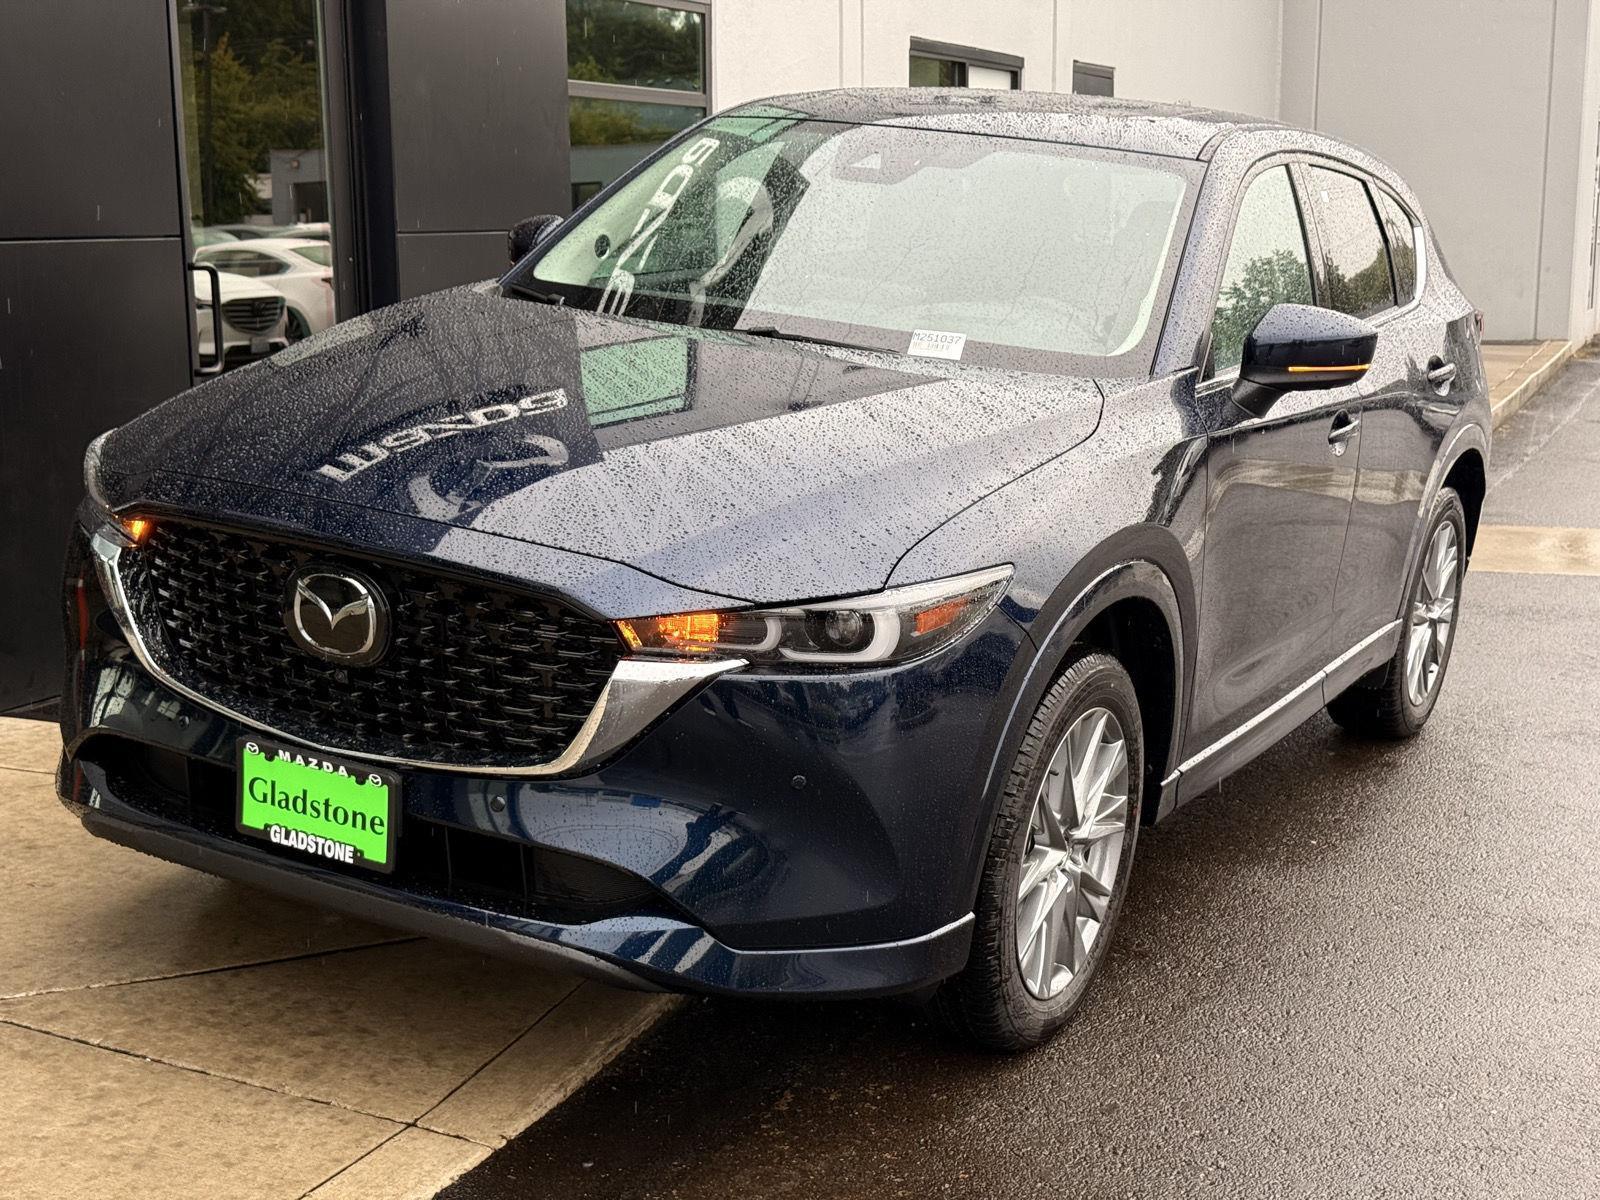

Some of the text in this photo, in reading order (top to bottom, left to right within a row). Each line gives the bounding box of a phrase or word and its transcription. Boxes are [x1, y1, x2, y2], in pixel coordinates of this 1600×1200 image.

[912, 332, 961, 345] M251037
[277, 749, 349, 777] MAZDA
[248, 776, 386, 836] Gladstone
[269, 824, 355, 864] GLADSTONE
